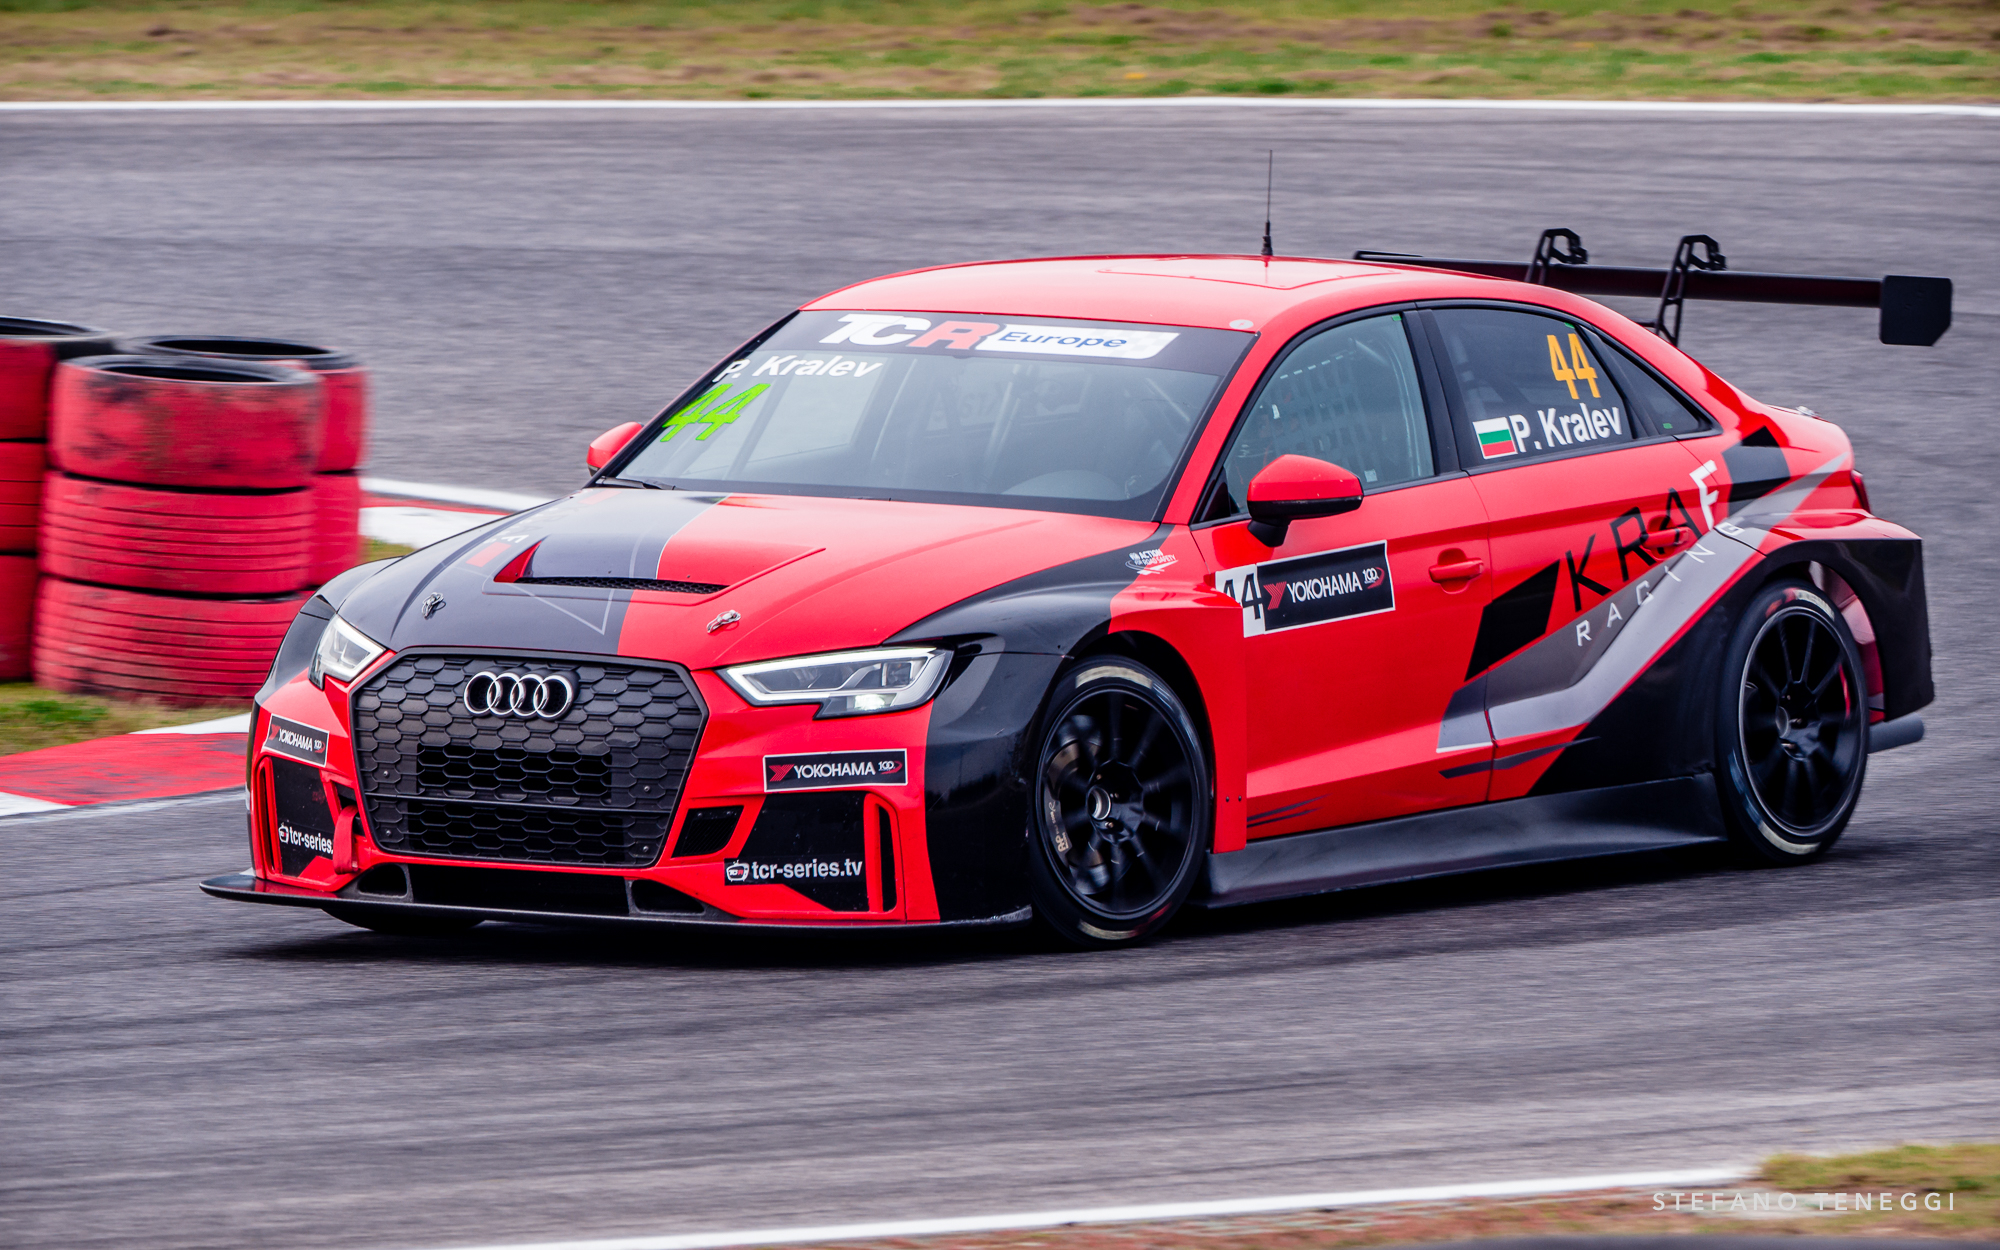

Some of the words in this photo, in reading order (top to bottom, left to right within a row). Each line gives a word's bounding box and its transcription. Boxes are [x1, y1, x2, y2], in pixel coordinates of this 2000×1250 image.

[818, 313, 1000, 350] TCR
[998, 331, 1127, 348] Europe
[712, 358, 751, 383] P.
[752, 355, 883, 377] Kralev
[1547, 333, 1601, 399] 44
[659, 383, 771, 442] 44
[1509, 414, 1542, 453] P.
[1537, 403, 1622, 447] Kralev
[1565, 460, 1719, 613] KRAF
[1286, 571, 1363, 603] YOKOHAMA
[1576, 521, 1745, 647] RACING
[279, 728, 313, 752] YOKOHAMA
[793, 761, 876, 779] YOKOHAMA
[289, 826, 334, 855] tcr-series.
[752, 858, 863, 880] tcr-series.tv
